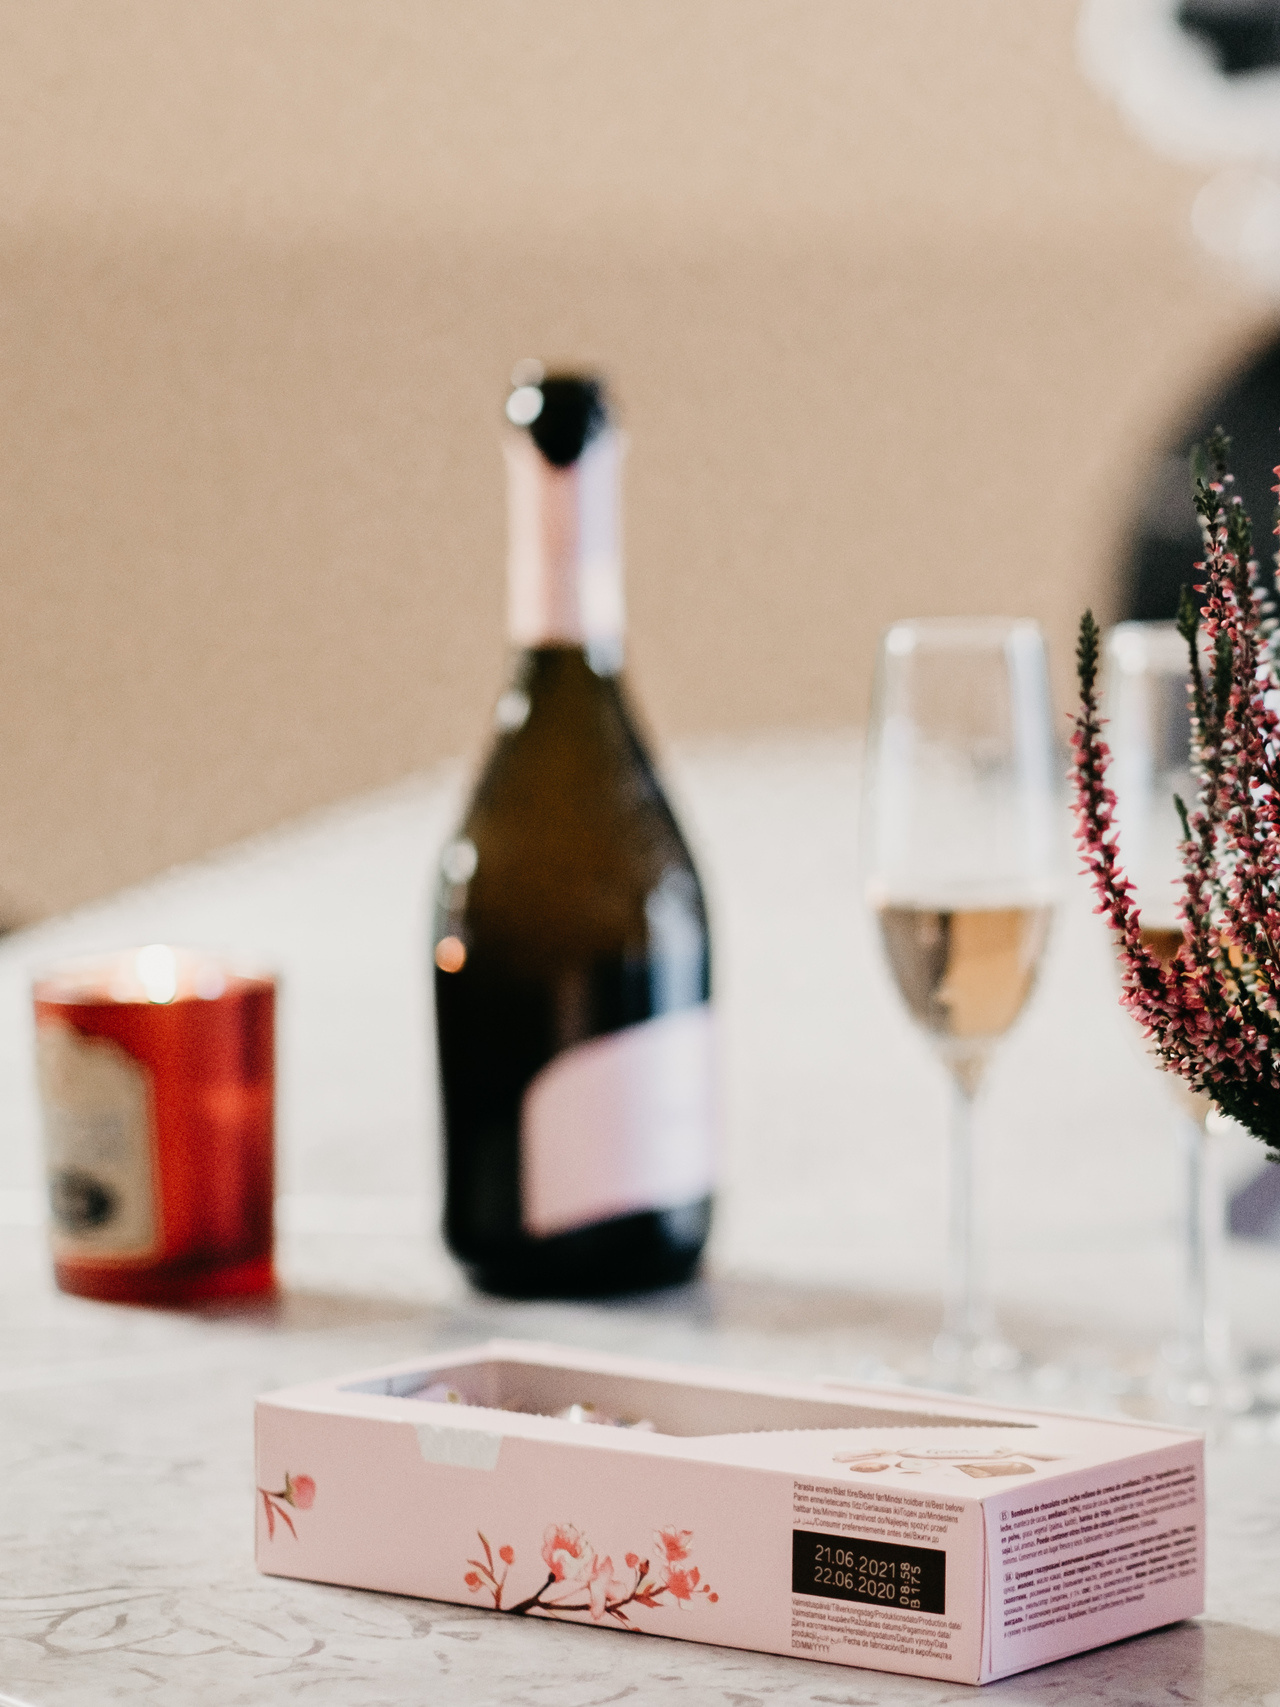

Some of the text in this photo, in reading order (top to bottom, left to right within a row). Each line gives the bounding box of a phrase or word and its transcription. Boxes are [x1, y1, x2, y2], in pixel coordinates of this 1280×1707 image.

[793, 1481, 814, 1492] Parasta
[903, 1497, 924, 1507] holdbar
[814, 1544, 896, 1579] 21.06.2021
[814, 1565, 896, 1600] 22.06.2020
[899, 1562, 911, 1605] 08:58
